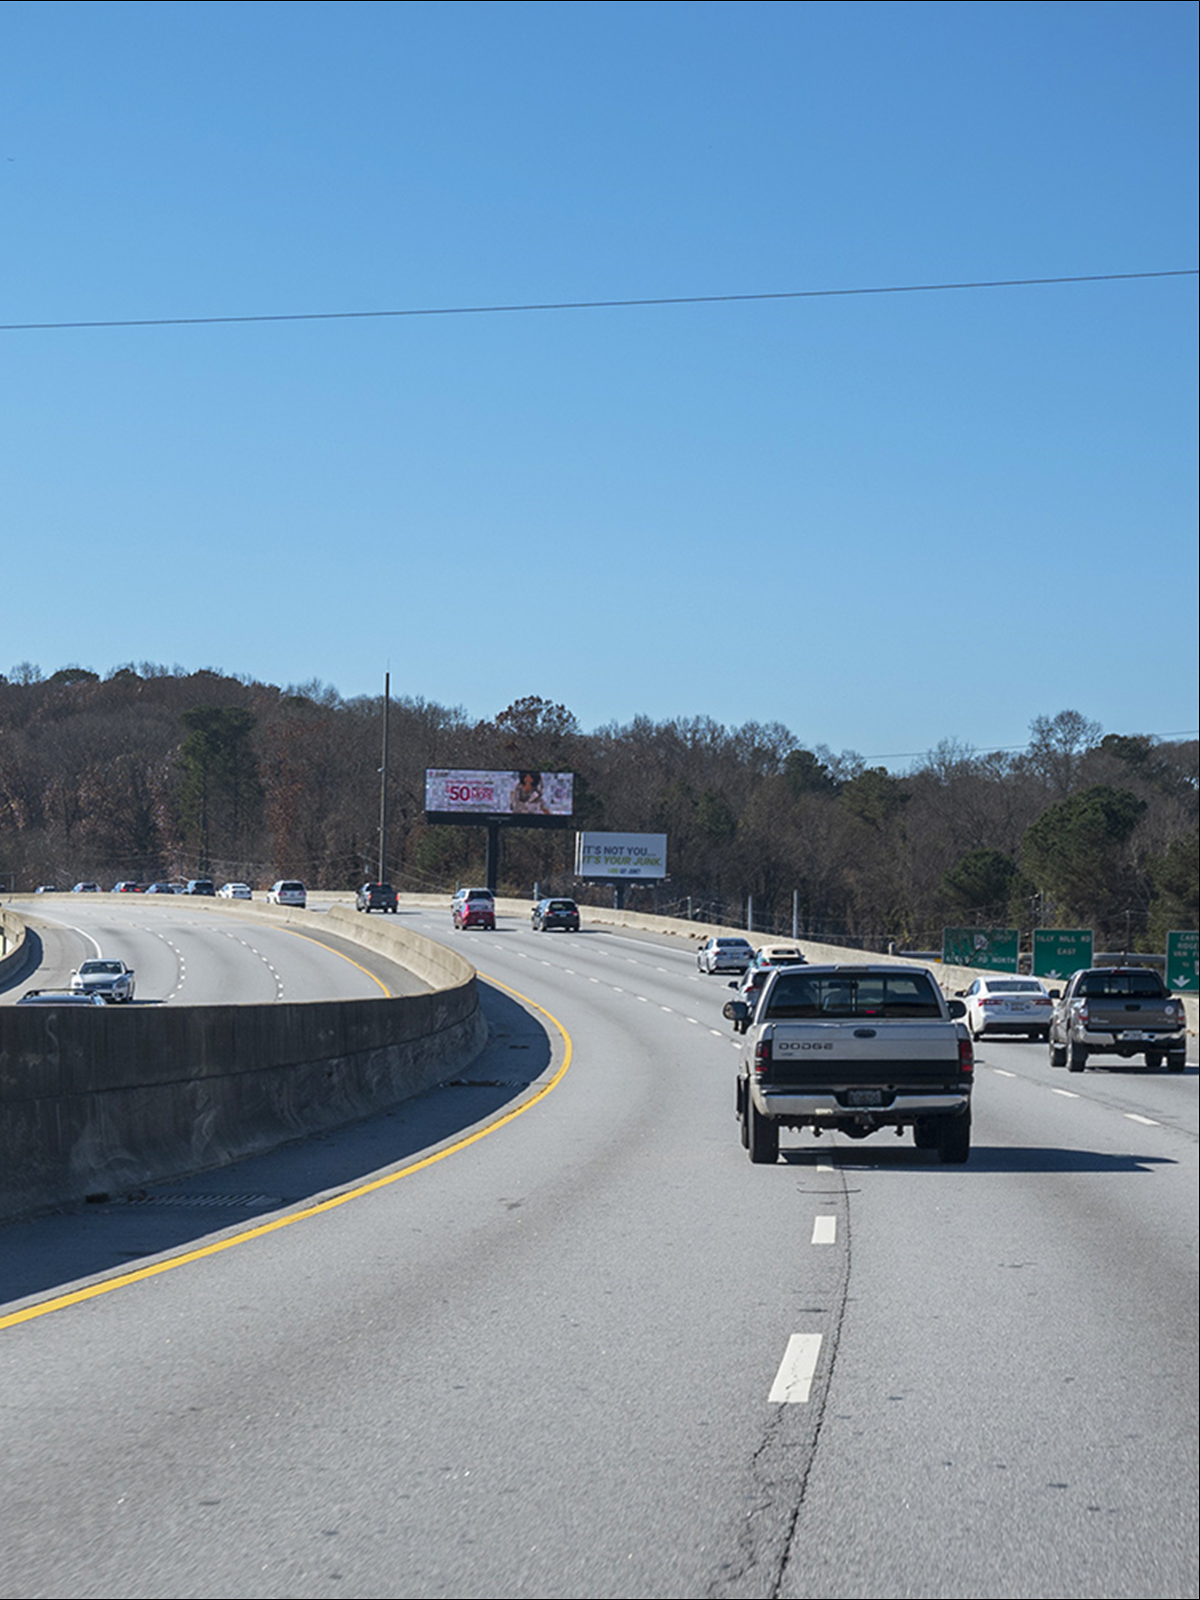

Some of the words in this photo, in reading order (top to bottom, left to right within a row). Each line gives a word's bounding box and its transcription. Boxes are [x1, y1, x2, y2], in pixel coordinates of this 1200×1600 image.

[583, 845, 601, 854] IT'S
[604, 846, 625, 855] NOT
[604, 856, 631, 865] YOUR
[779, 1042, 833, 1050] DODGE
